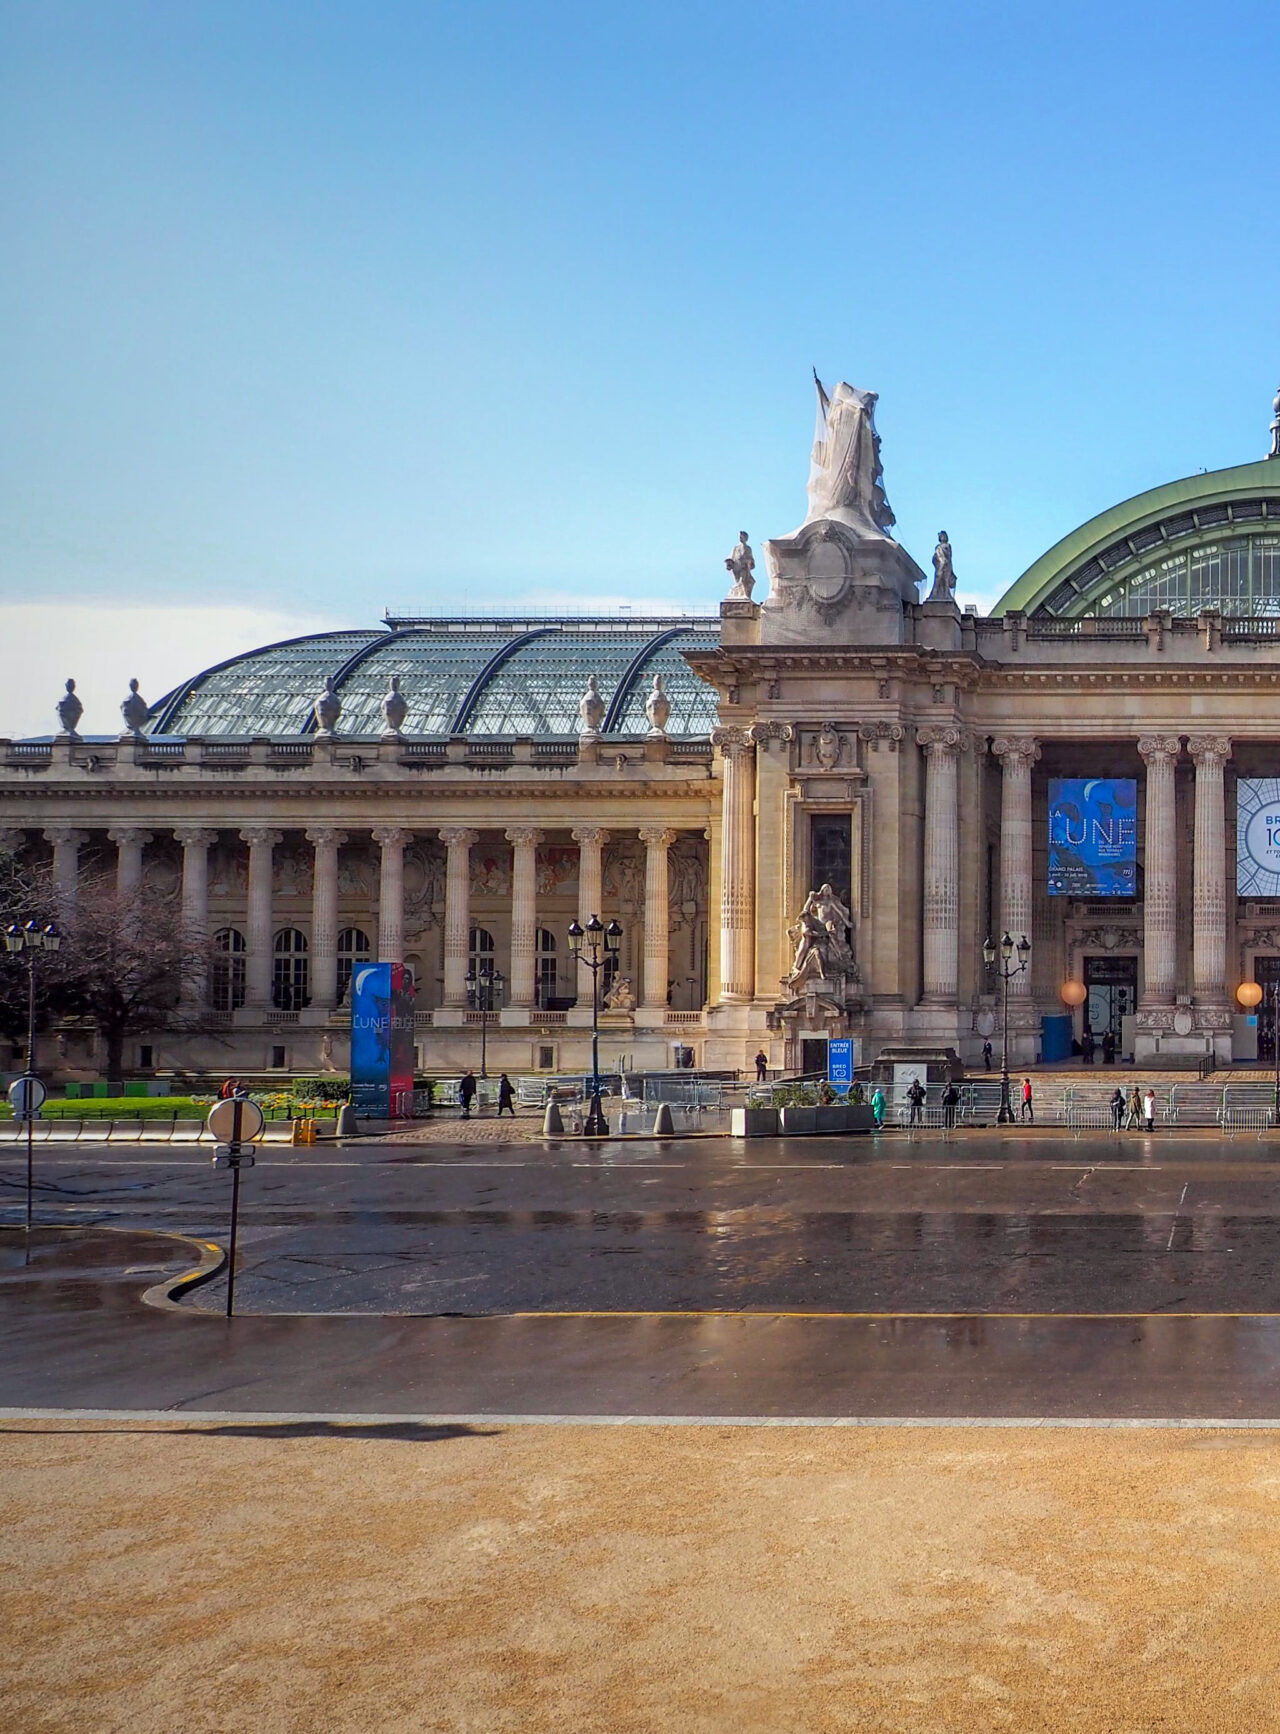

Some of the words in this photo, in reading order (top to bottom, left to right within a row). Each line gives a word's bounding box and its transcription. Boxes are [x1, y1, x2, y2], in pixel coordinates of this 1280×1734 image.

[1049, 810, 1062, 818] LA
[1049, 818, 1135, 845] LUNE
[353, 1017, 389, 1028] LUNE
